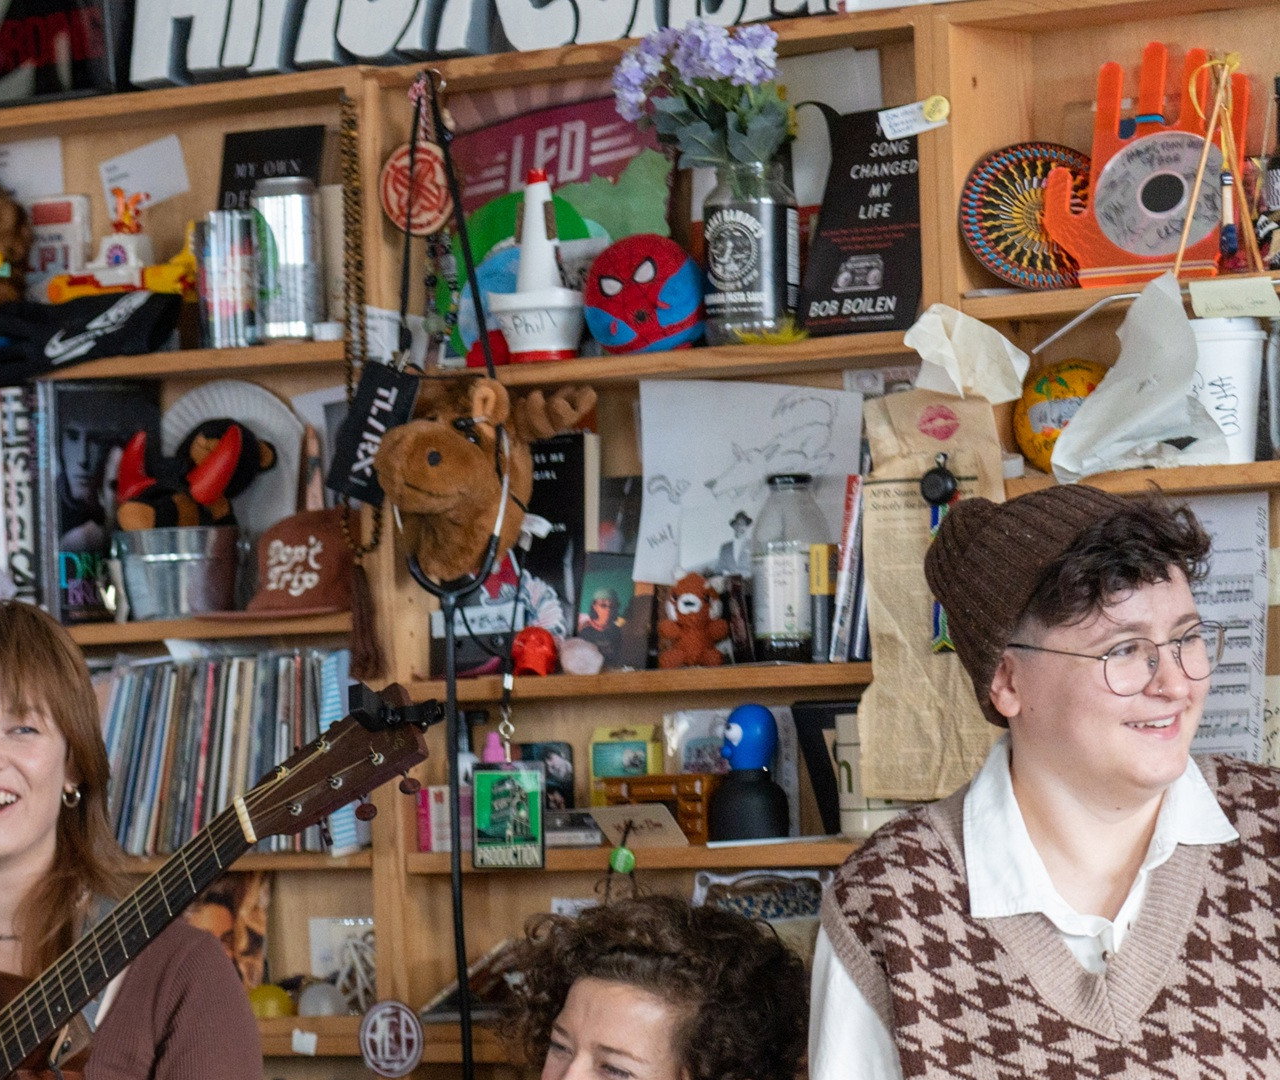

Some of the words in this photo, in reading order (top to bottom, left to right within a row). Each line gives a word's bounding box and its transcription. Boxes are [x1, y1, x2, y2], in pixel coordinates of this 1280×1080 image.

[868, 139, 911, 159] SONG
[849, 159, 919, 180] CHANGED
[867, 182, 892, 199] MY
[858, 203, 893, 220] LIFE
[808, 299, 841, 318] BOB
[841, 295, 898, 315] BOILEN
[475, 846, 541, 867] PRODUCTION
